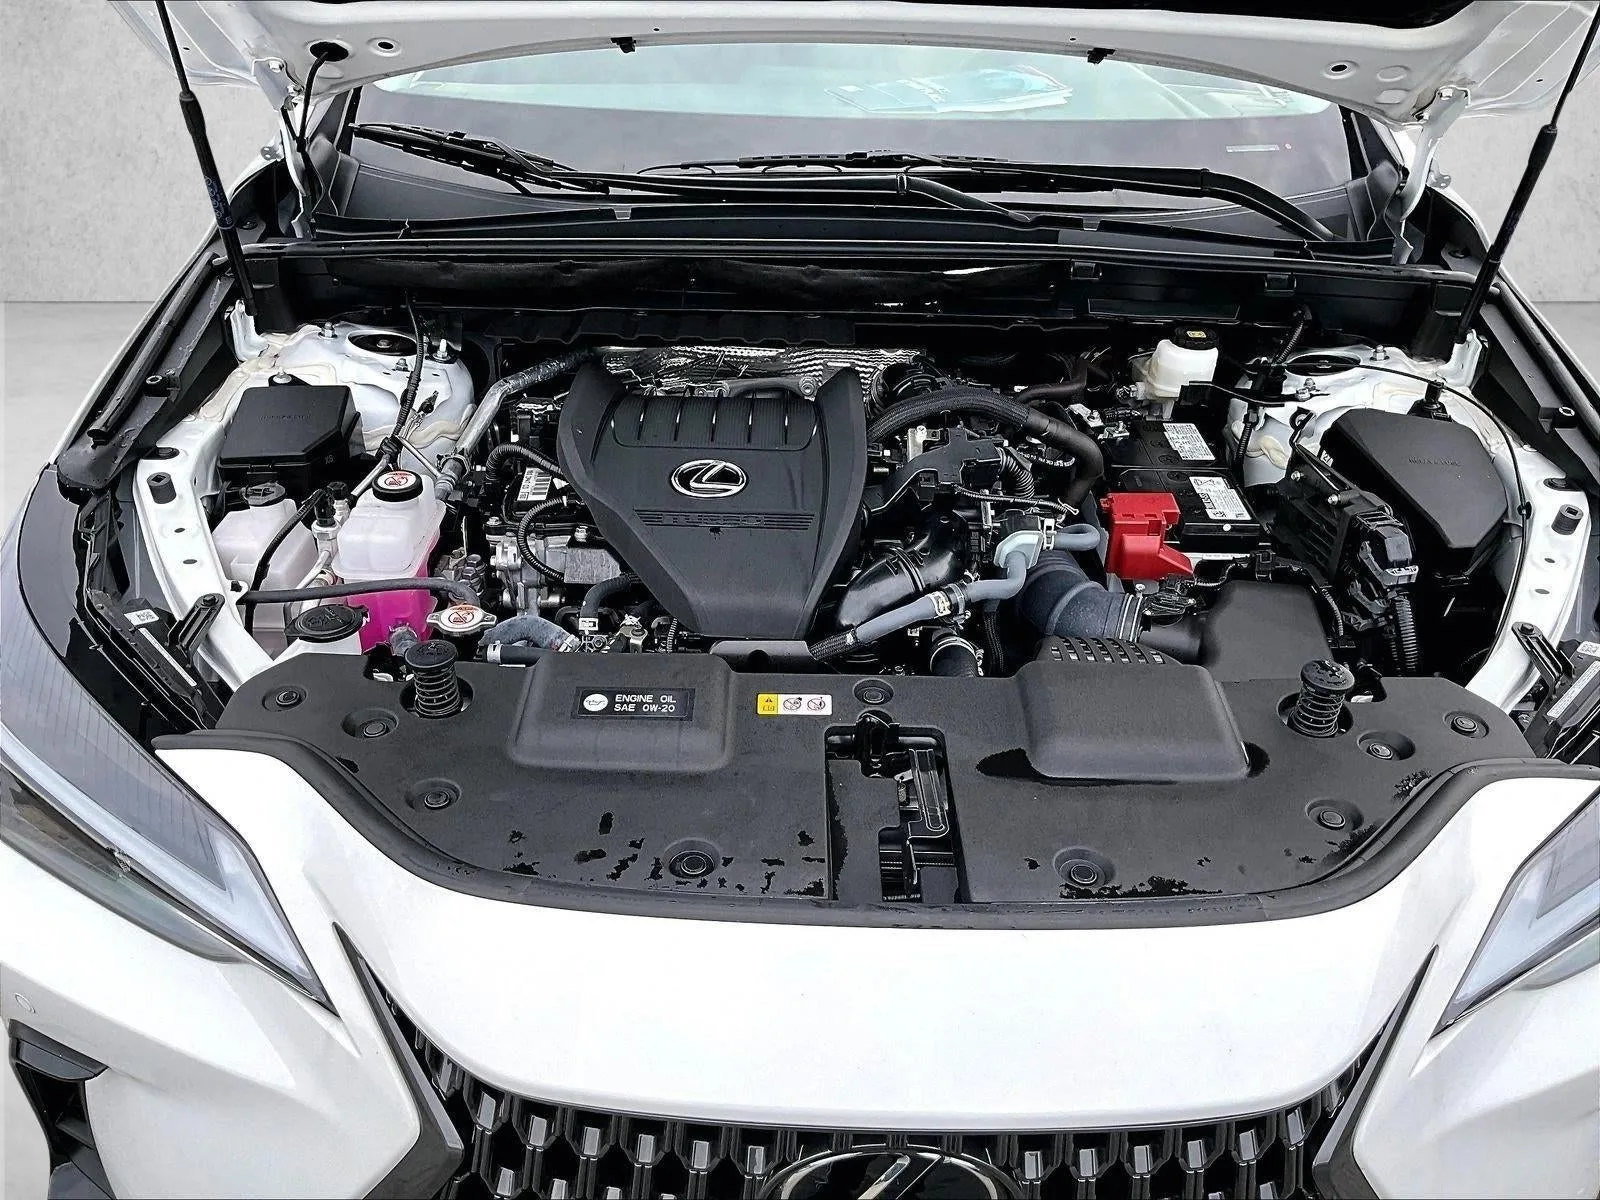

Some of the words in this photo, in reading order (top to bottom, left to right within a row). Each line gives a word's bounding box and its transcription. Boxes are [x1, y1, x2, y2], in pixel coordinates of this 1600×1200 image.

[615, 694, 654, 703] ENGINE
[660, 694, 677, 704] OIL
[613, 703, 636, 712] SAE
[642, 704, 676, 713] 0W-20
